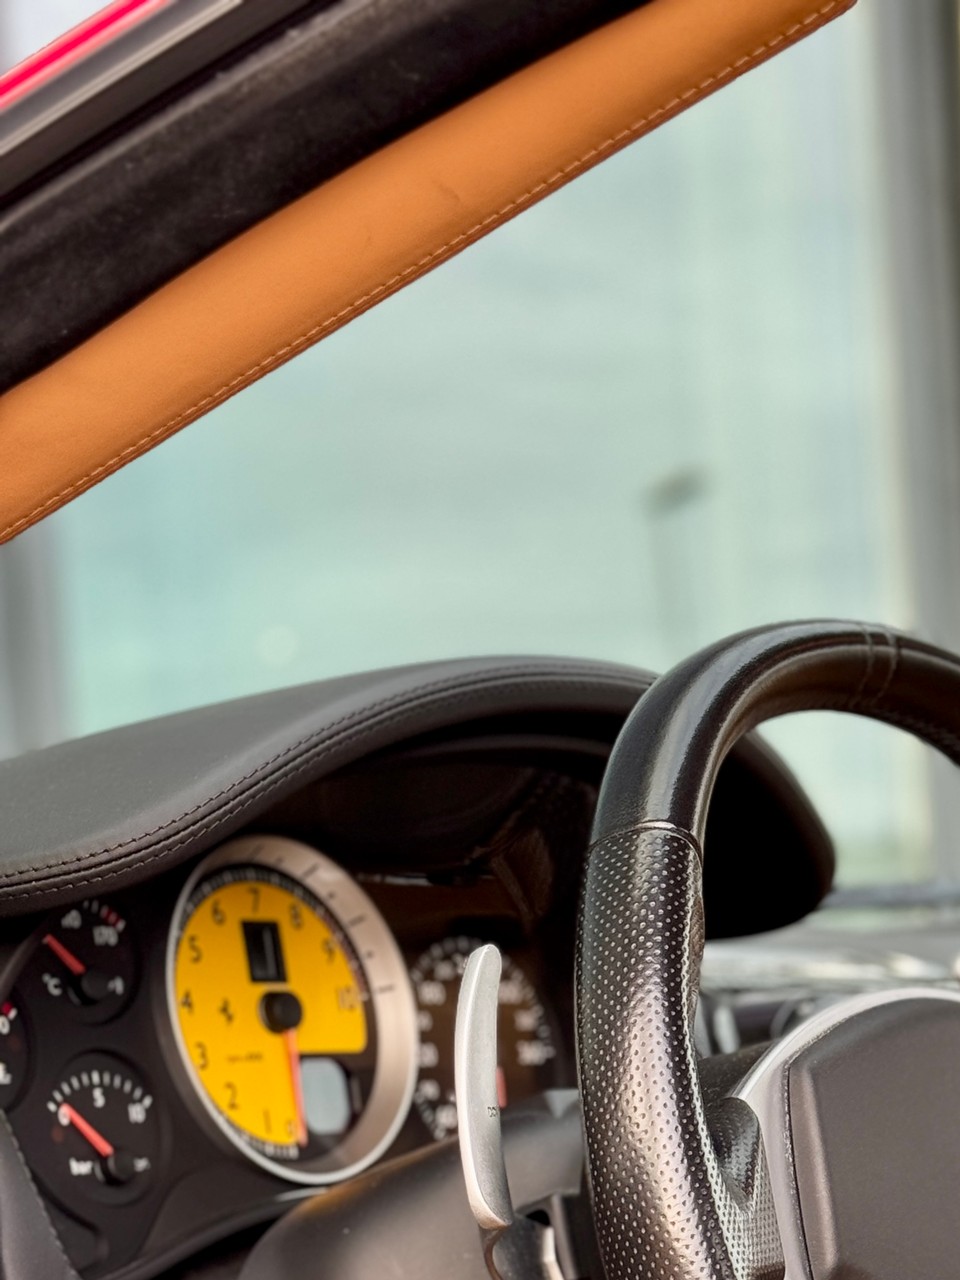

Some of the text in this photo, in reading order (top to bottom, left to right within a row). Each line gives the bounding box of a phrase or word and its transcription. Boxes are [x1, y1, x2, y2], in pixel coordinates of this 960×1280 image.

[247, 886, 261, 912] 7
[211, 900, 226, 926] 6
[288, 902, 304, 929] 8
[188, 935, 203, 964] 5
[322, 938, 338, 965] 9
[181, 991, 193, 1014] 4
[195, 1042, 209, 1071] 3
[92, 1087, 105, 1108] 5
[223, 1081, 238, 1110] 2
[128, 1102, 147, 1123] 10
[69, 1157, 93, 1176] bar
